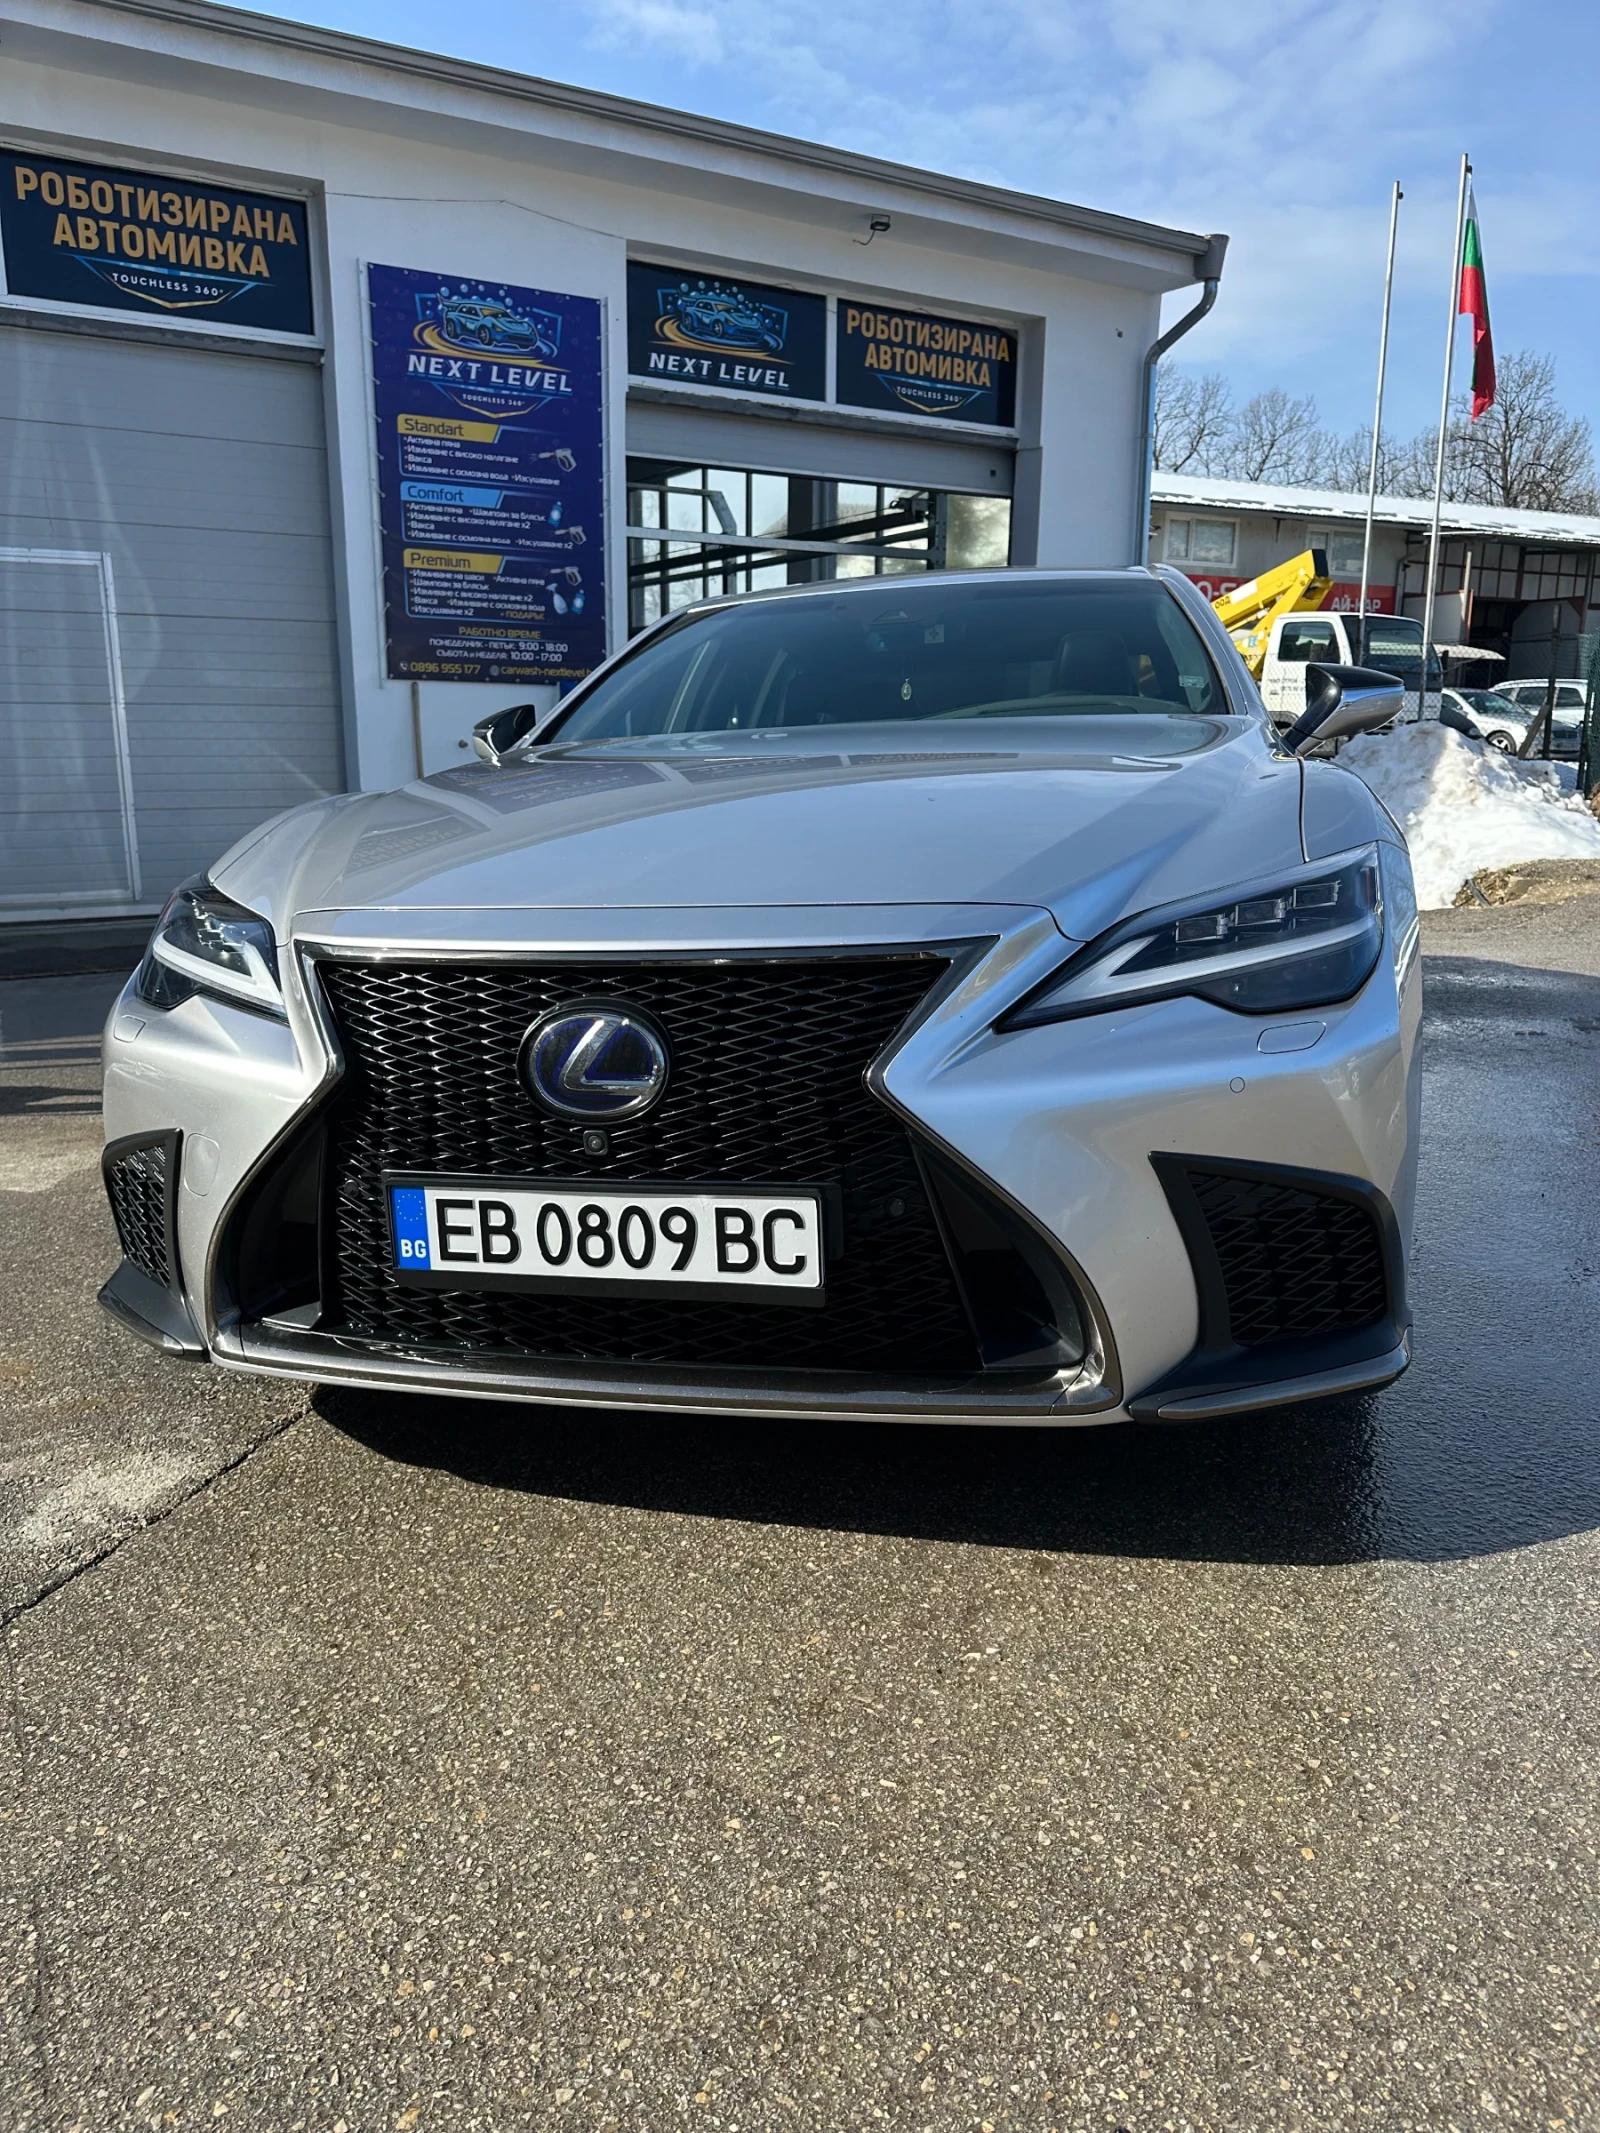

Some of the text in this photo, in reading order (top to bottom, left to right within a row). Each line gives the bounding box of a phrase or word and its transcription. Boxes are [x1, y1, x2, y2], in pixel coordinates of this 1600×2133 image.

[14, 165, 298, 246] РОБОТИЗИРАНА
[53, 212, 271, 278] АВТОМИВКА
[111, 272, 189, 292] TOUCHLESS
[846, 308, 1010, 362] РОБОТИЗИРАНА
[648, 351, 789, 389] NEXT LEVEL
[864, 342, 991, 387] АВТОМИВКА
[407, 354, 573, 393] NEXT LEVEL
[462, 393, 506, 405] TOUCHLESS
[896, 386, 942, 400] TOUCHLESS
[404, 418, 464, 437] Standart
[407, 436, 440, 446] Активна
[407, 445, 448, 456] Измиване
[455, 451, 483, 459] високо
[408, 454, 432, 464] Вакса
[408, 464, 449, 474] Измиване
[407, 485, 464, 503] Comfort
[410, 503, 443, 512] Активна
[410, 512, 451, 522] Измиване
[410, 520, 435, 530] Вакса
[410, 552, 471, 568] Premium
[414, 596, 439, 605] Вакса
[459, 627, 541, 639] РАБОТНО ВРЕМЕ
[428, 638, 483, 648] ПОНЕДЕЛНИК
[518, 642, 539, 651] 9:00
[545, 643, 569, 652] 18:00
[435, 649, 469, 658] СЪБОТА
[510, 651, 534, 660] 10:00
[540, 653, 563, 662] 17:00
[410, 661, 481, 675] 0896 955 177
[435, 1198, 807, 1274] EB 0809 BC
[400, 1238, 427, 1258] BG
